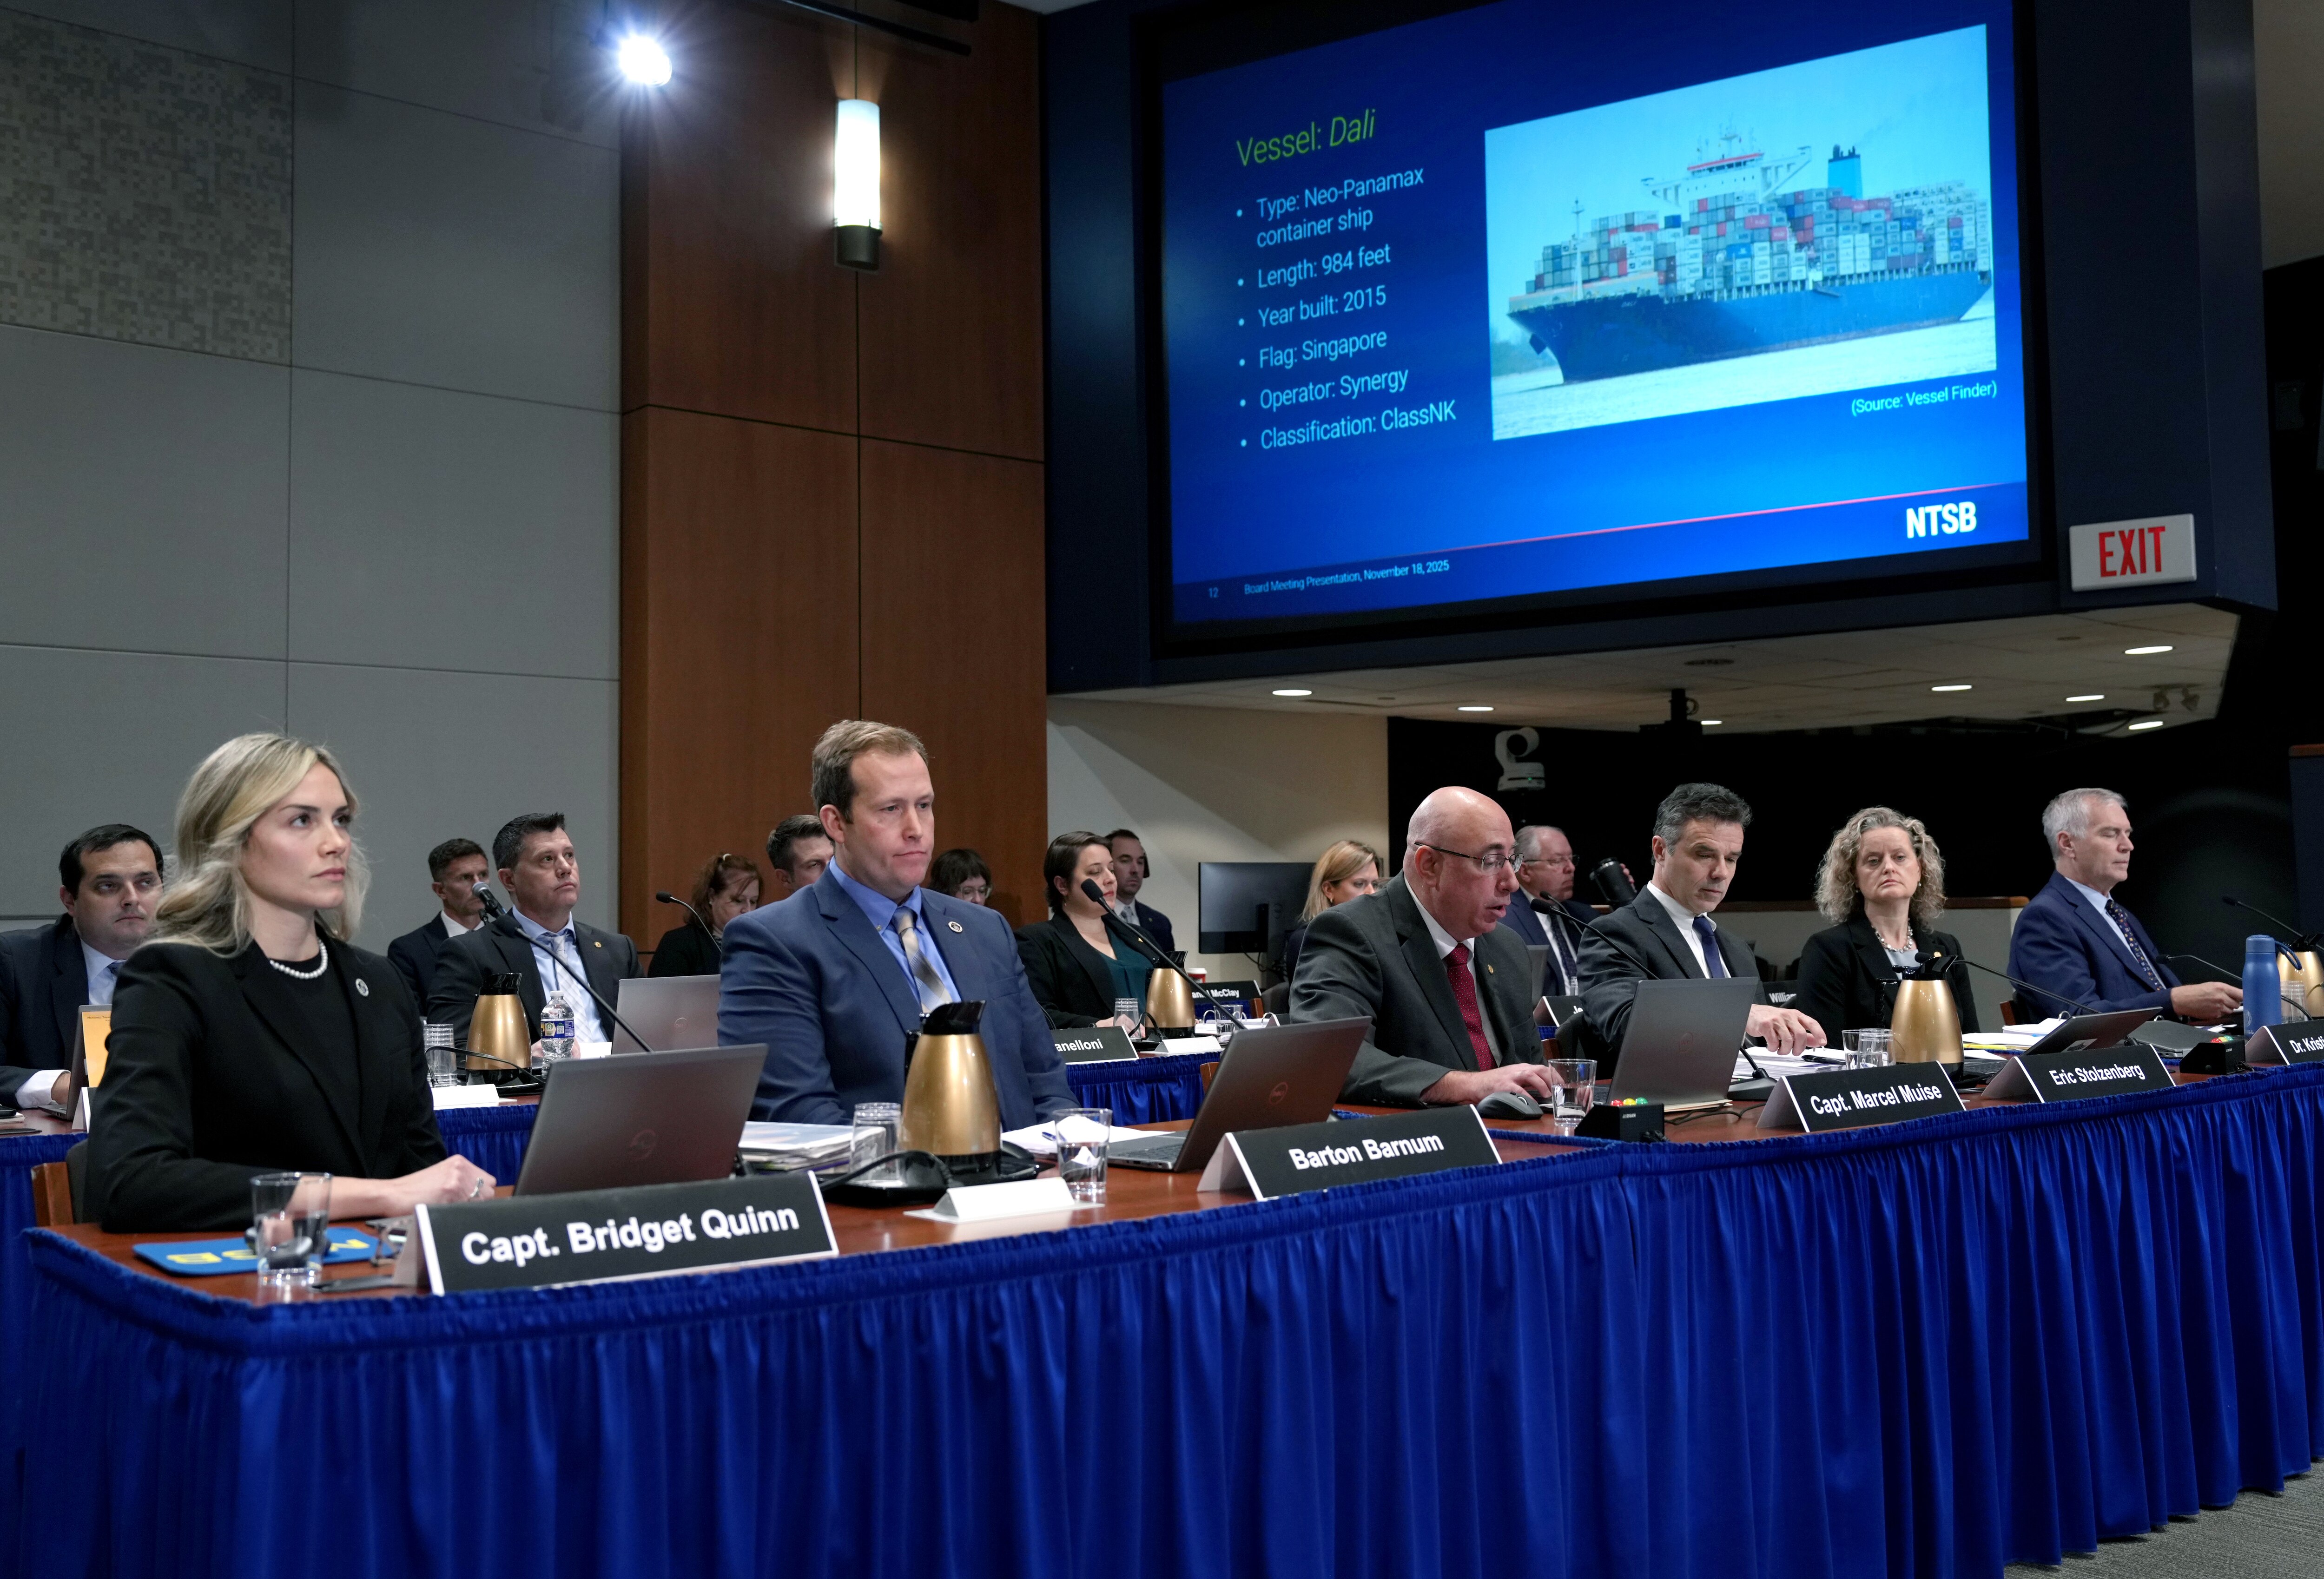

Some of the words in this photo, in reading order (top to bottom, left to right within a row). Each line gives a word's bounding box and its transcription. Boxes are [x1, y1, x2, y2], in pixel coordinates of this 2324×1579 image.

[1236, 121, 1321, 166] Vessel:
[1329, 109, 1375, 147] Dali
[1257, 195, 1300, 221] Type:
[1305, 168, 1424, 208] Neo-Panamax
[1257, 217, 1333, 248] container
[1338, 207, 1373, 231] ship
[1258, 259, 1317, 288] Length:
[1321, 251, 1353, 276] 984
[1359, 244, 1390, 269] feet
[1259, 305, 1294, 327] Year
[1300, 295, 1339, 320] built:
[1343, 285, 1386, 312] 2015
[1260, 347, 1297, 369] Flag:
[1302, 331, 1387, 362] Singapore
[1260, 381, 1335, 412] Operator:
[1340, 369, 1408, 399] Synergy
[1851, 395, 1903, 417] (Source:
[1906, 387, 1948, 407] Vessel
[1952, 380, 1997, 401] Finder)
[1261, 415, 1376, 449] Classification:
[1381, 400, 1456, 430] ClassNK
[1906, 500, 1977, 539] NTSB
[2098, 526, 2166, 577] EXIT
[1209, 588, 1219, 599] 12
[1244, 581, 1269, 595] Board
[1271, 577, 1305, 592] Meeting
[1306, 570, 1362, 586] Presentation,
[1364, 564, 1409, 580] November
[1412, 562, 1425, 576] 18,
[1426, 559, 1450, 573] 2025
[1210, 988, 1240, 998] McClay
[1769, 992, 1797, 1003] Willia
[1054, 1038, 1103, 1052] anelloni
[2289, 1040, 2306, 1053] Dr.
[2049, 1068, 2077, 1086] Eric
[2075, 1063, 2146, 1083] Stolzenberg
[1810, 1093, 1851, 1117] Capt.
[1850, 1086, 1900, 1109] Marcel
[1898, 1083, 1942, 1103] Muise
[1288, 1145, 1363, 1170] Barton
[1362, 1135, 1445, 1160] Barnum
[462, 1227, 560, 1267] Capt.
[566, 1213, 697, 1253] Bridget
[701, 1205, 799, 1239] Quinn
